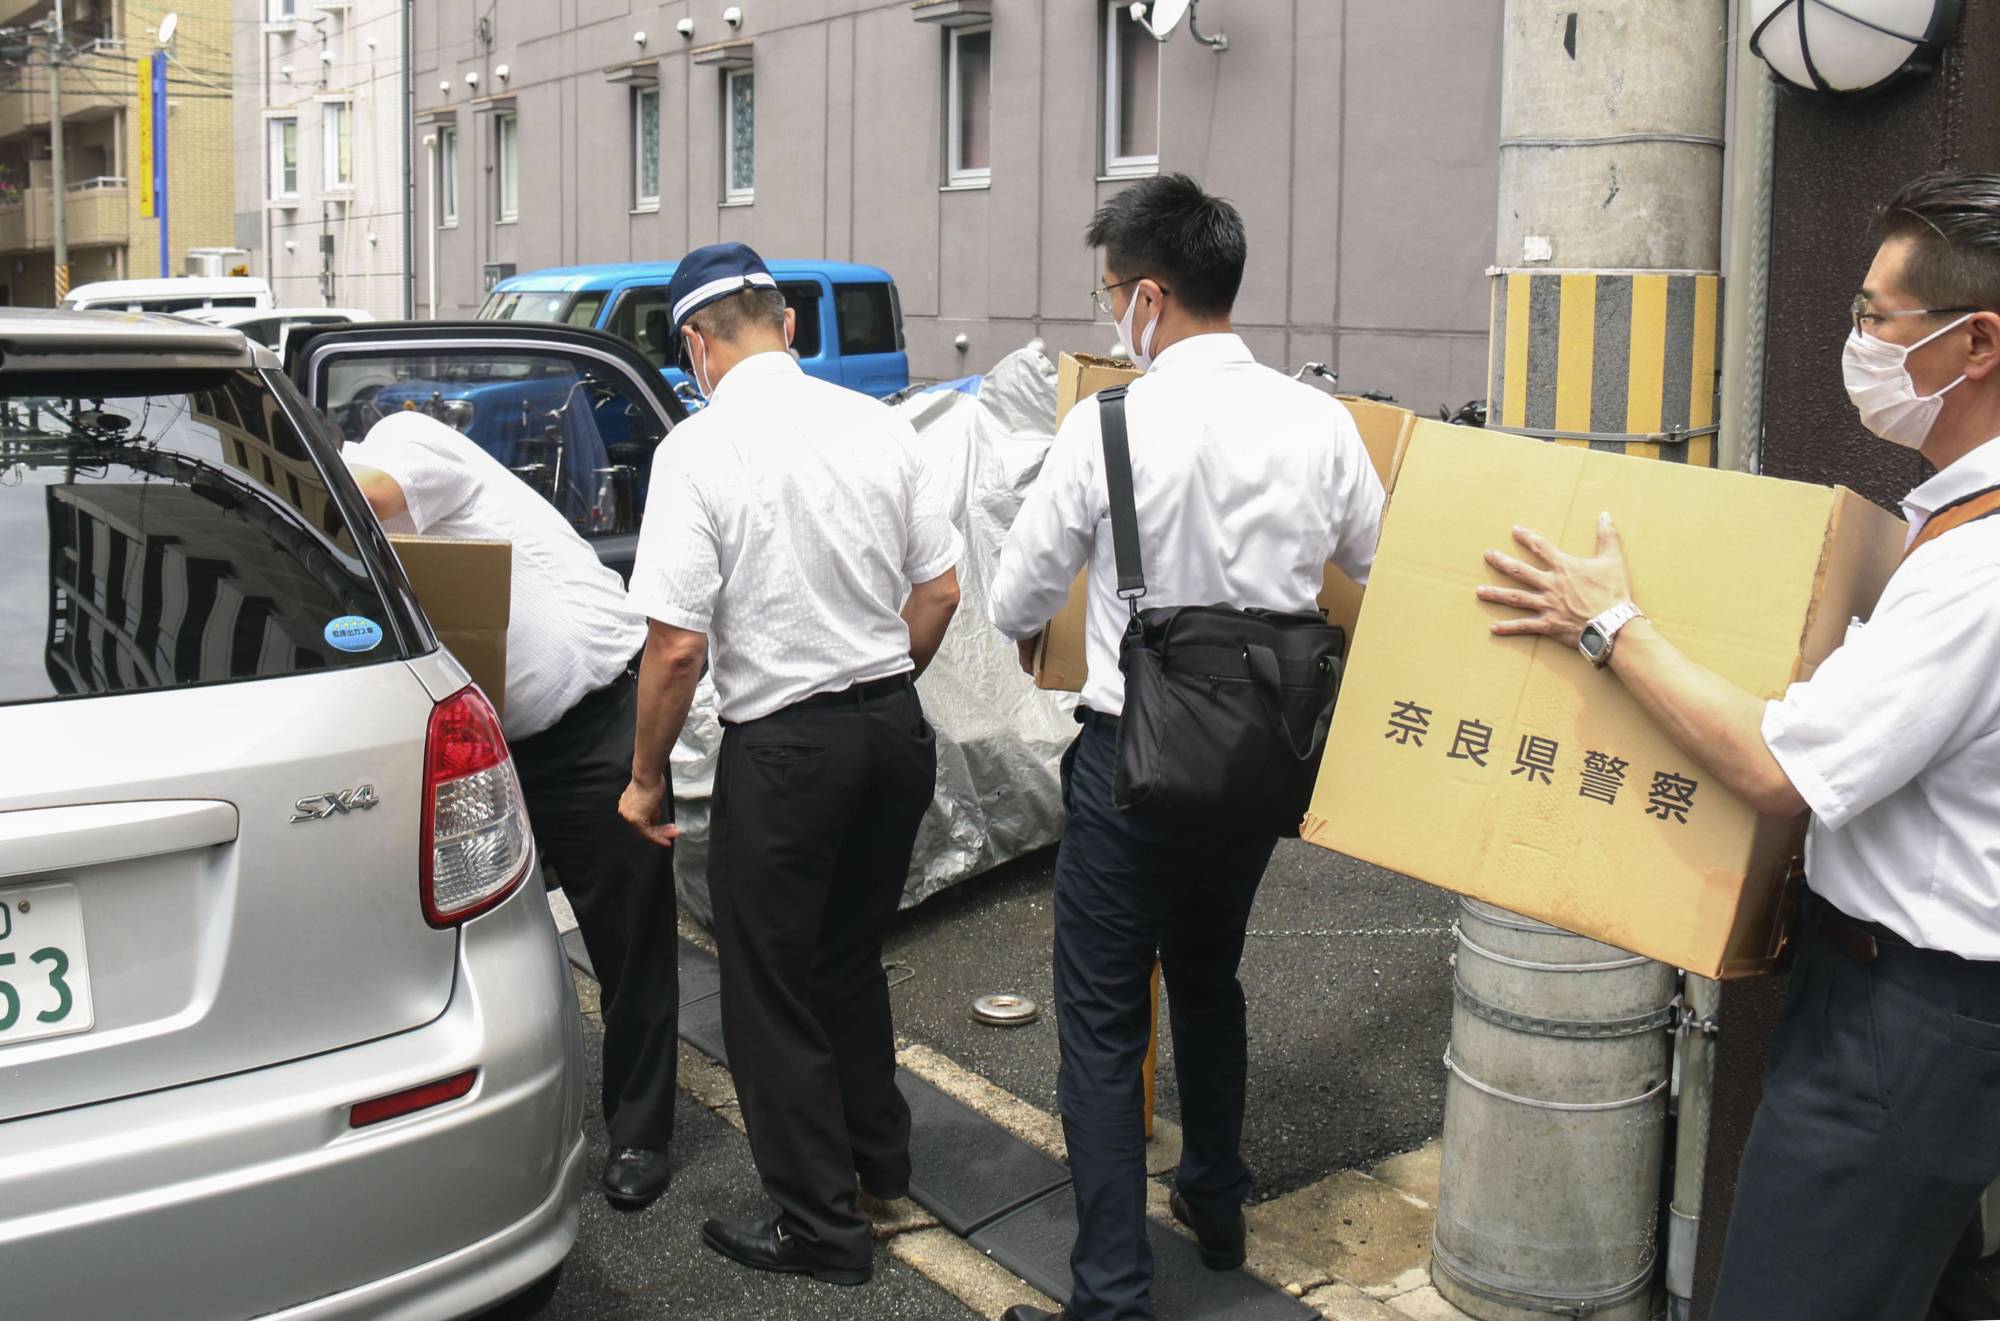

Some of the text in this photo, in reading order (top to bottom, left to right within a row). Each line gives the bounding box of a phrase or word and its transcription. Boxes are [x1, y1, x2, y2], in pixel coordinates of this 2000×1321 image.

[289, 784, 379, 823] SX4
[1385, 700, 1699, 825] 奈良県警察
